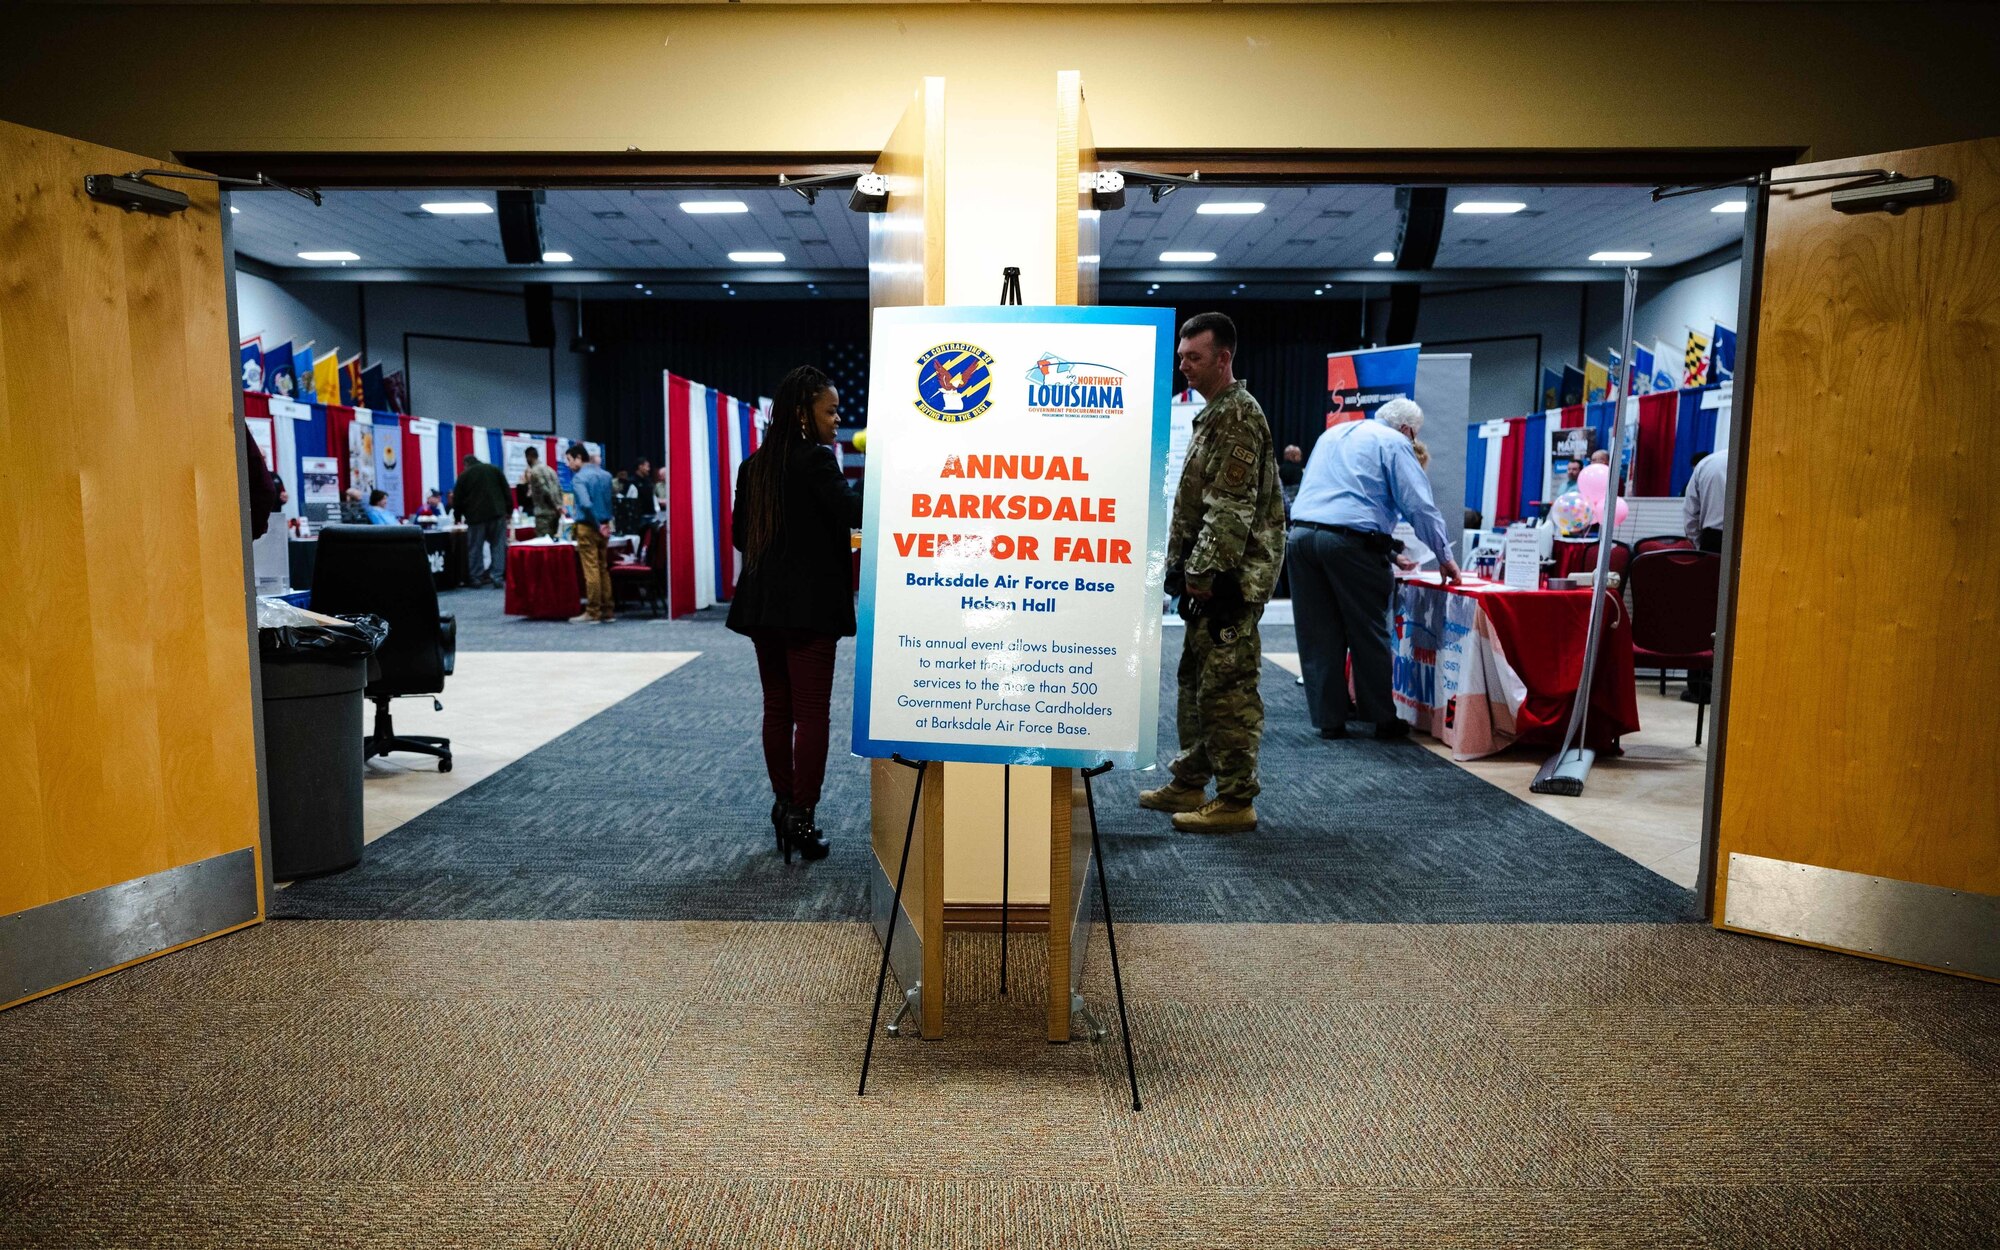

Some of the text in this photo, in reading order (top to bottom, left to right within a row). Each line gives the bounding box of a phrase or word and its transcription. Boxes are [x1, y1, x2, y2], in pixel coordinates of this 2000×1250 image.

[930, 343, 982, 356] CONTRACTING
[1077, 376, 1123, 386] NORTHWEST
[1028, 384, 1124, 408] LOUISIANA
[918, 403, 988, 422] BUYING FOR THE BEST
[1234, 448, 1254, 460] SF
[940, 454, 1089, 481] ANNUAL
[911, 494, 1116, 522] BARKSDALE
[1054, 537, 1132, 564] FAIR
[906, 573, 1115, 592] Barksdale Air Force Base
[961, 597, 1056, 613] Hoban Hall
[899, 635, 1117, 655] This annual event allows businesses
[920, 656, 1092, 676] to market their products and
[913, 678, 1098, 695] services to the more than 500
[897, 696, 1112, 716] Government Purchase Cardholders
[915, 717, 1090, 736] at Barksdale Air Force Base.
